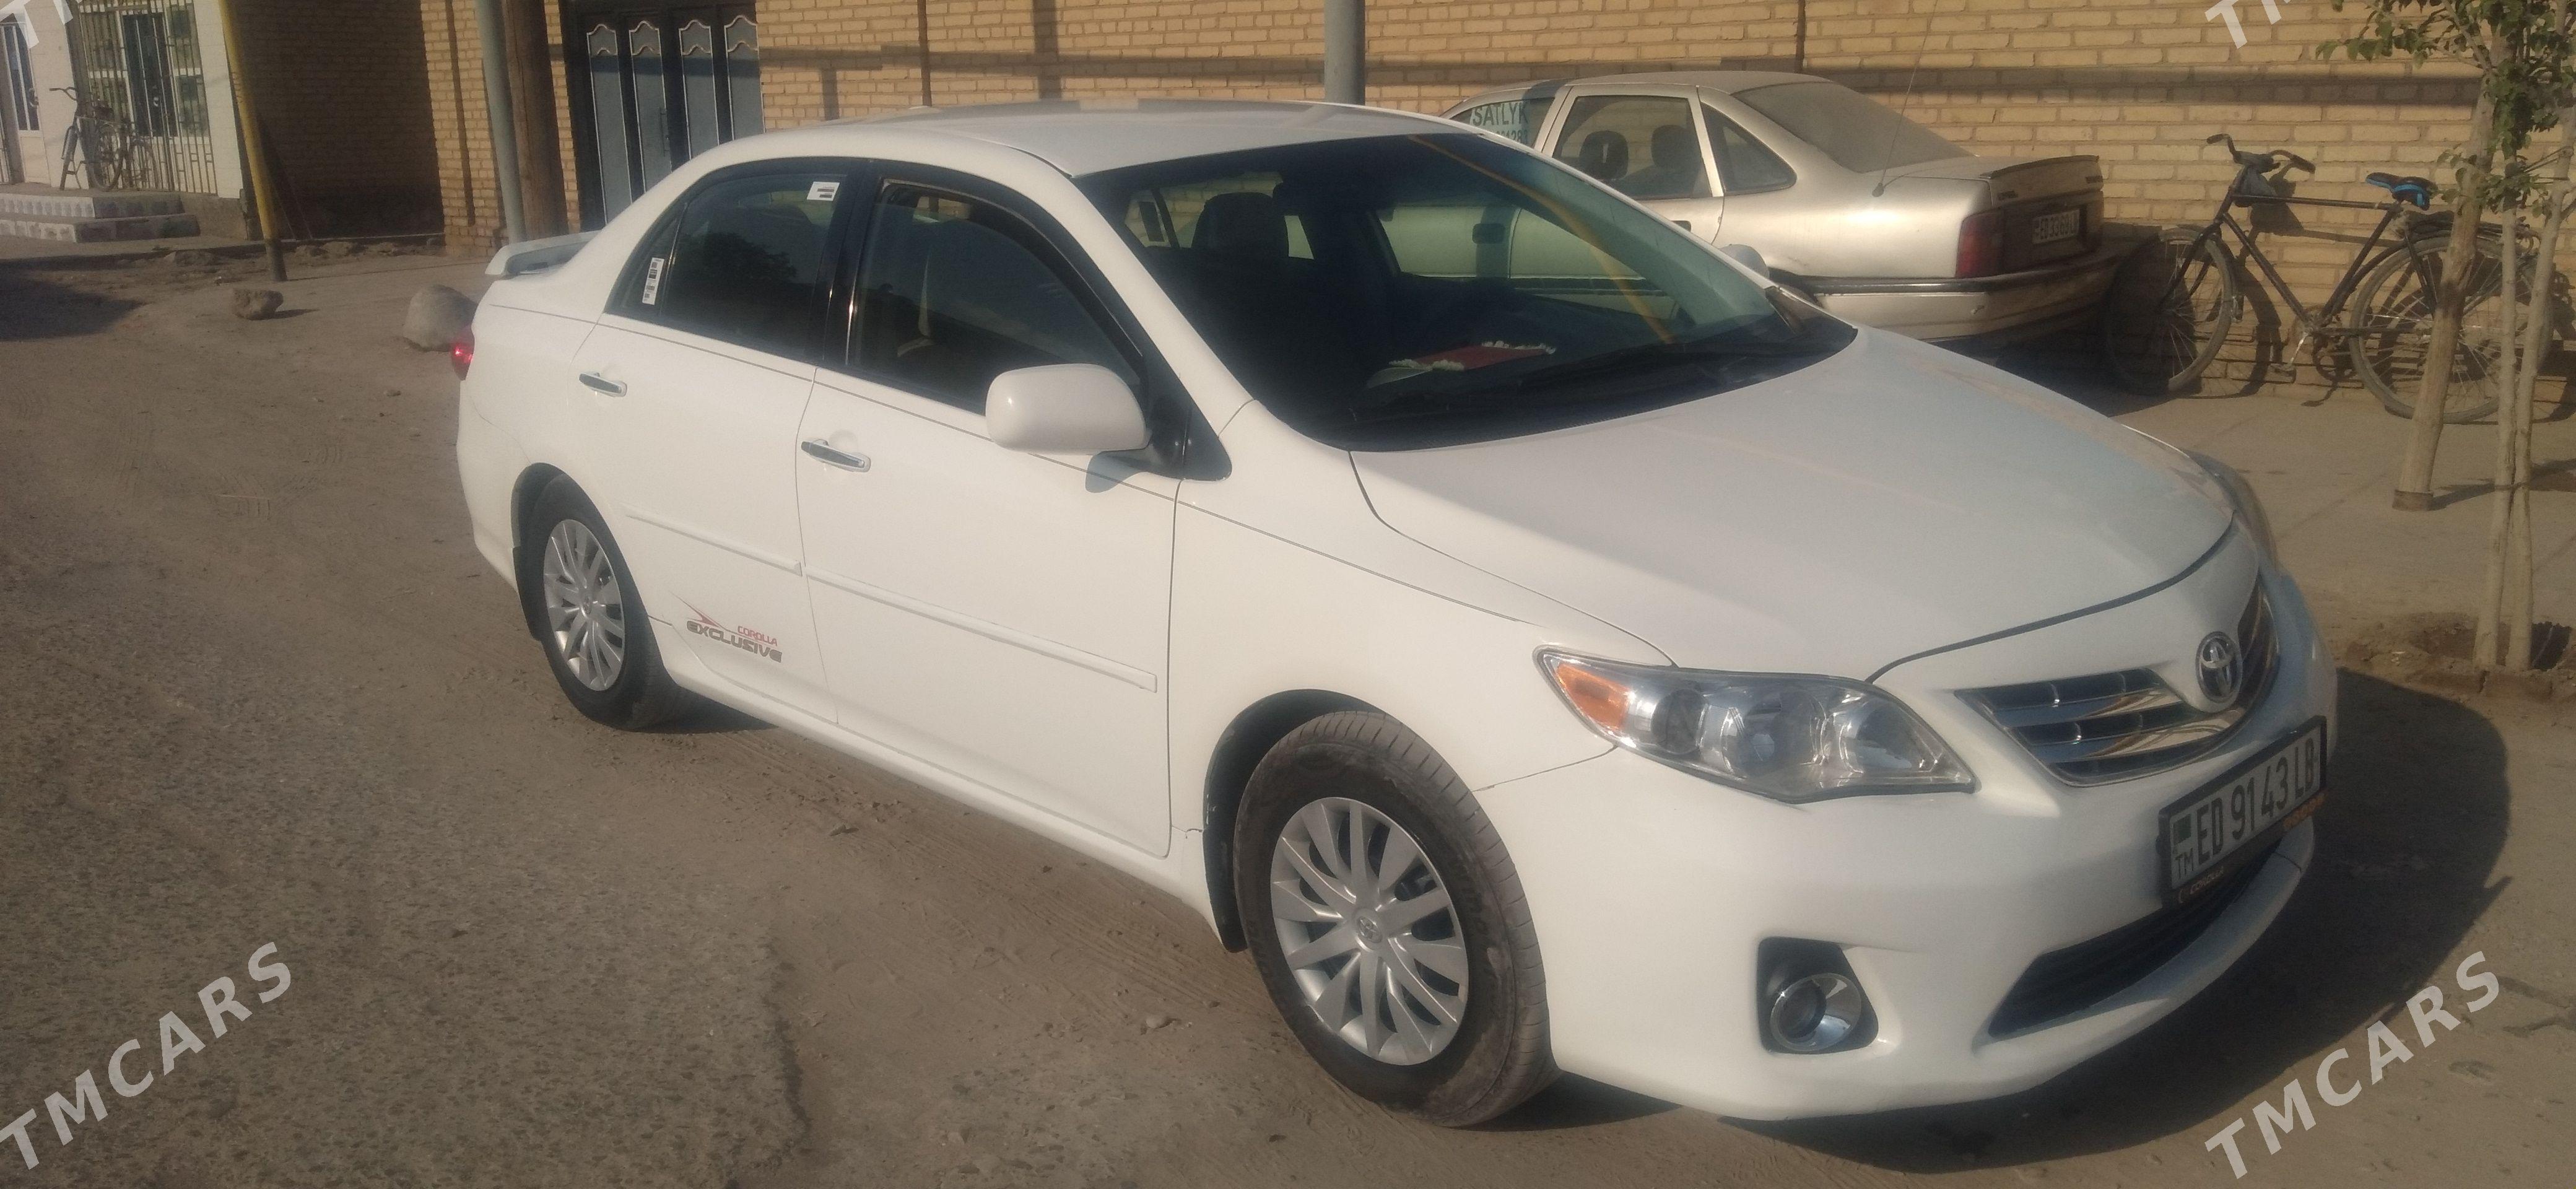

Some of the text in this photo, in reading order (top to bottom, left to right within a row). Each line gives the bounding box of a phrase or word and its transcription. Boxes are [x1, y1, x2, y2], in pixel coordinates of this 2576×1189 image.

[1473, 102, 1528, 126] SATLYK
[686, 621, 783, 663] EXCLUSIVE
[737, 625, 778, 647] COROLLA
[2196, 797, 2224, 866] ED
[2231, 777, 2255, 840] 91
[2261, 757, 2289, 818] 43
[2294, 738, 2315, 799] LB
[2175, 847, 2194, 879] TM
